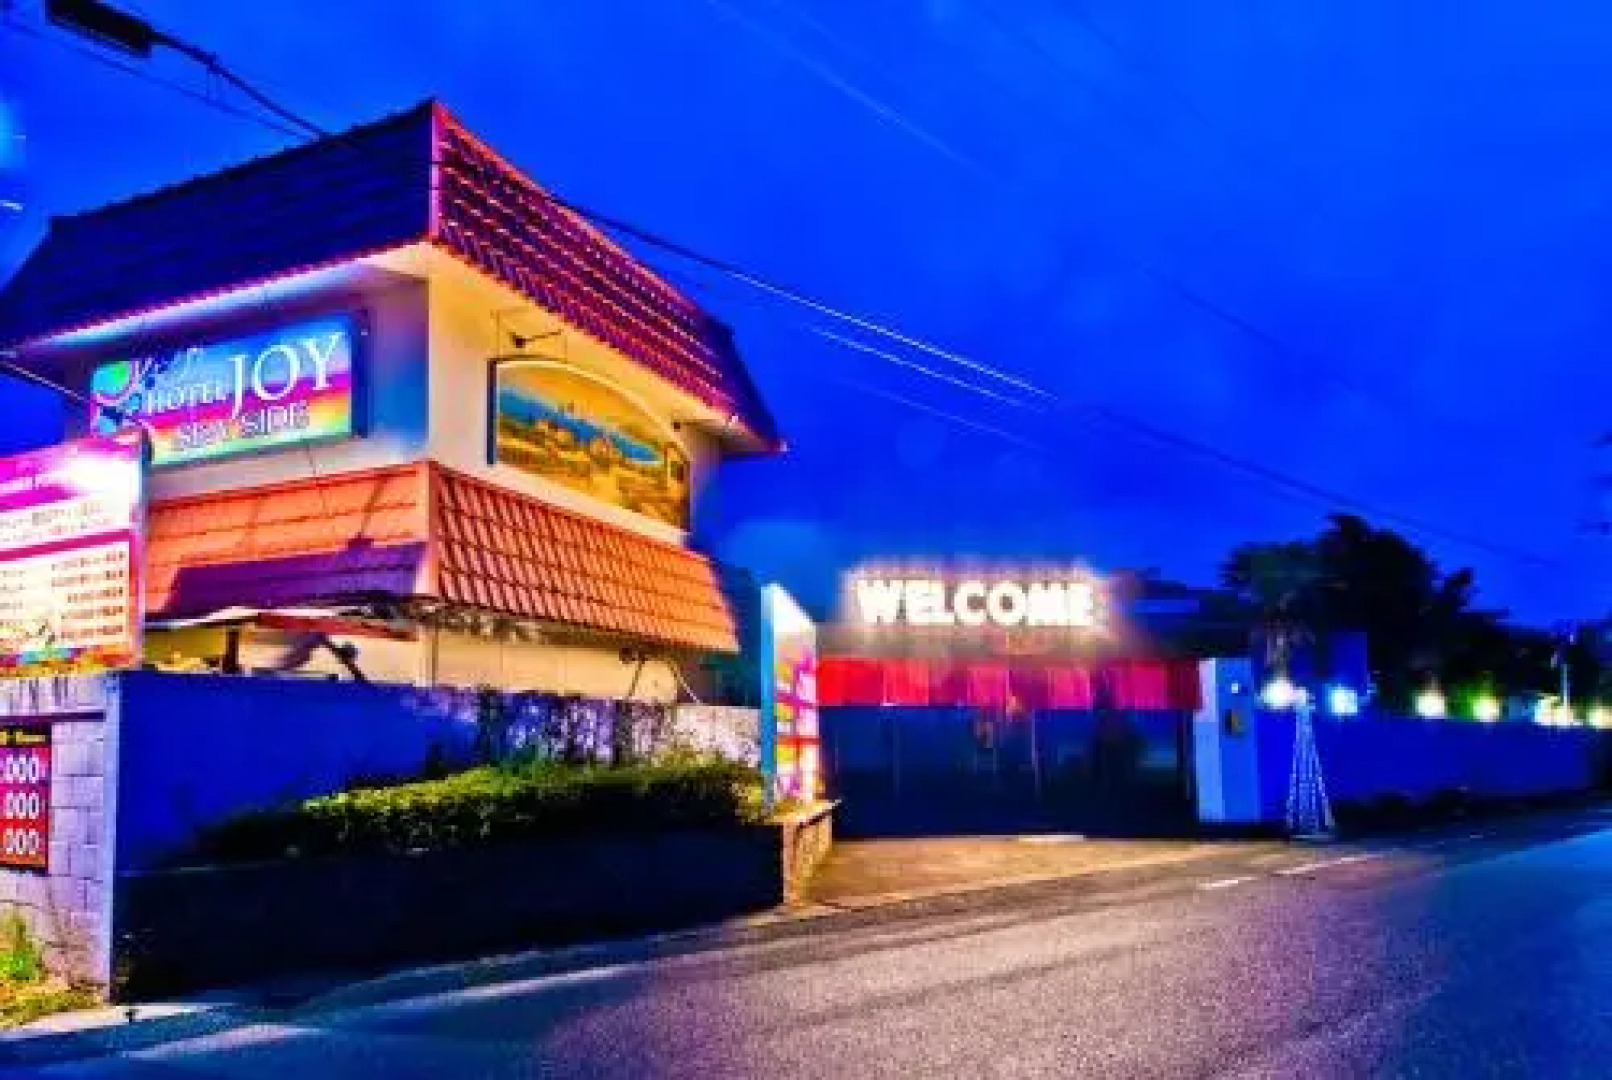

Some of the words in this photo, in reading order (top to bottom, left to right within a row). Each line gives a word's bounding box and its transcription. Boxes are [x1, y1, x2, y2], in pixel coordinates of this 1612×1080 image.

[146, 382, 228, 414] HOTEL
[228, 331, 343, 418] JOY
[856, 577, 1096, 627] WELCOME
